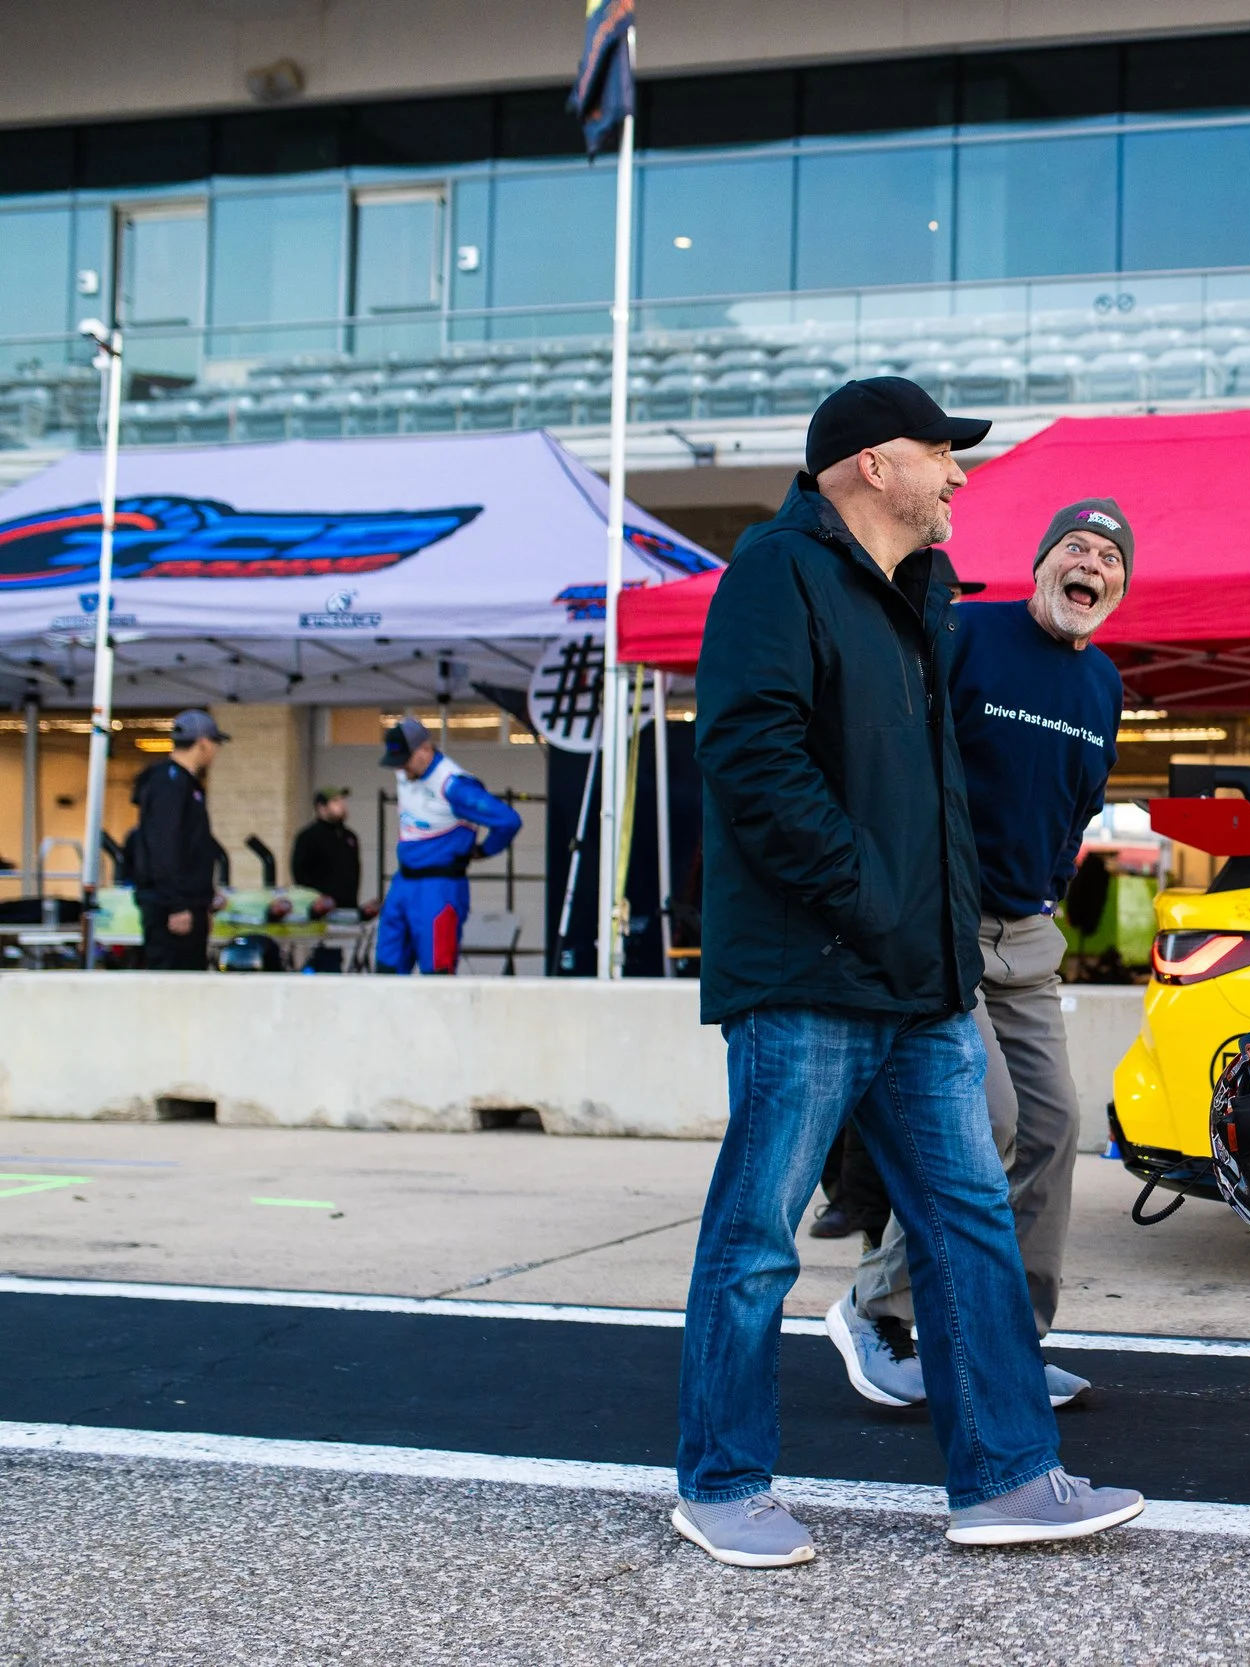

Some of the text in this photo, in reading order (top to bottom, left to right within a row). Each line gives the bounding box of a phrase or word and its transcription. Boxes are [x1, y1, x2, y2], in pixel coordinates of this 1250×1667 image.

[984, 702, 1104, 748] Drive Fast and Don't Suck
